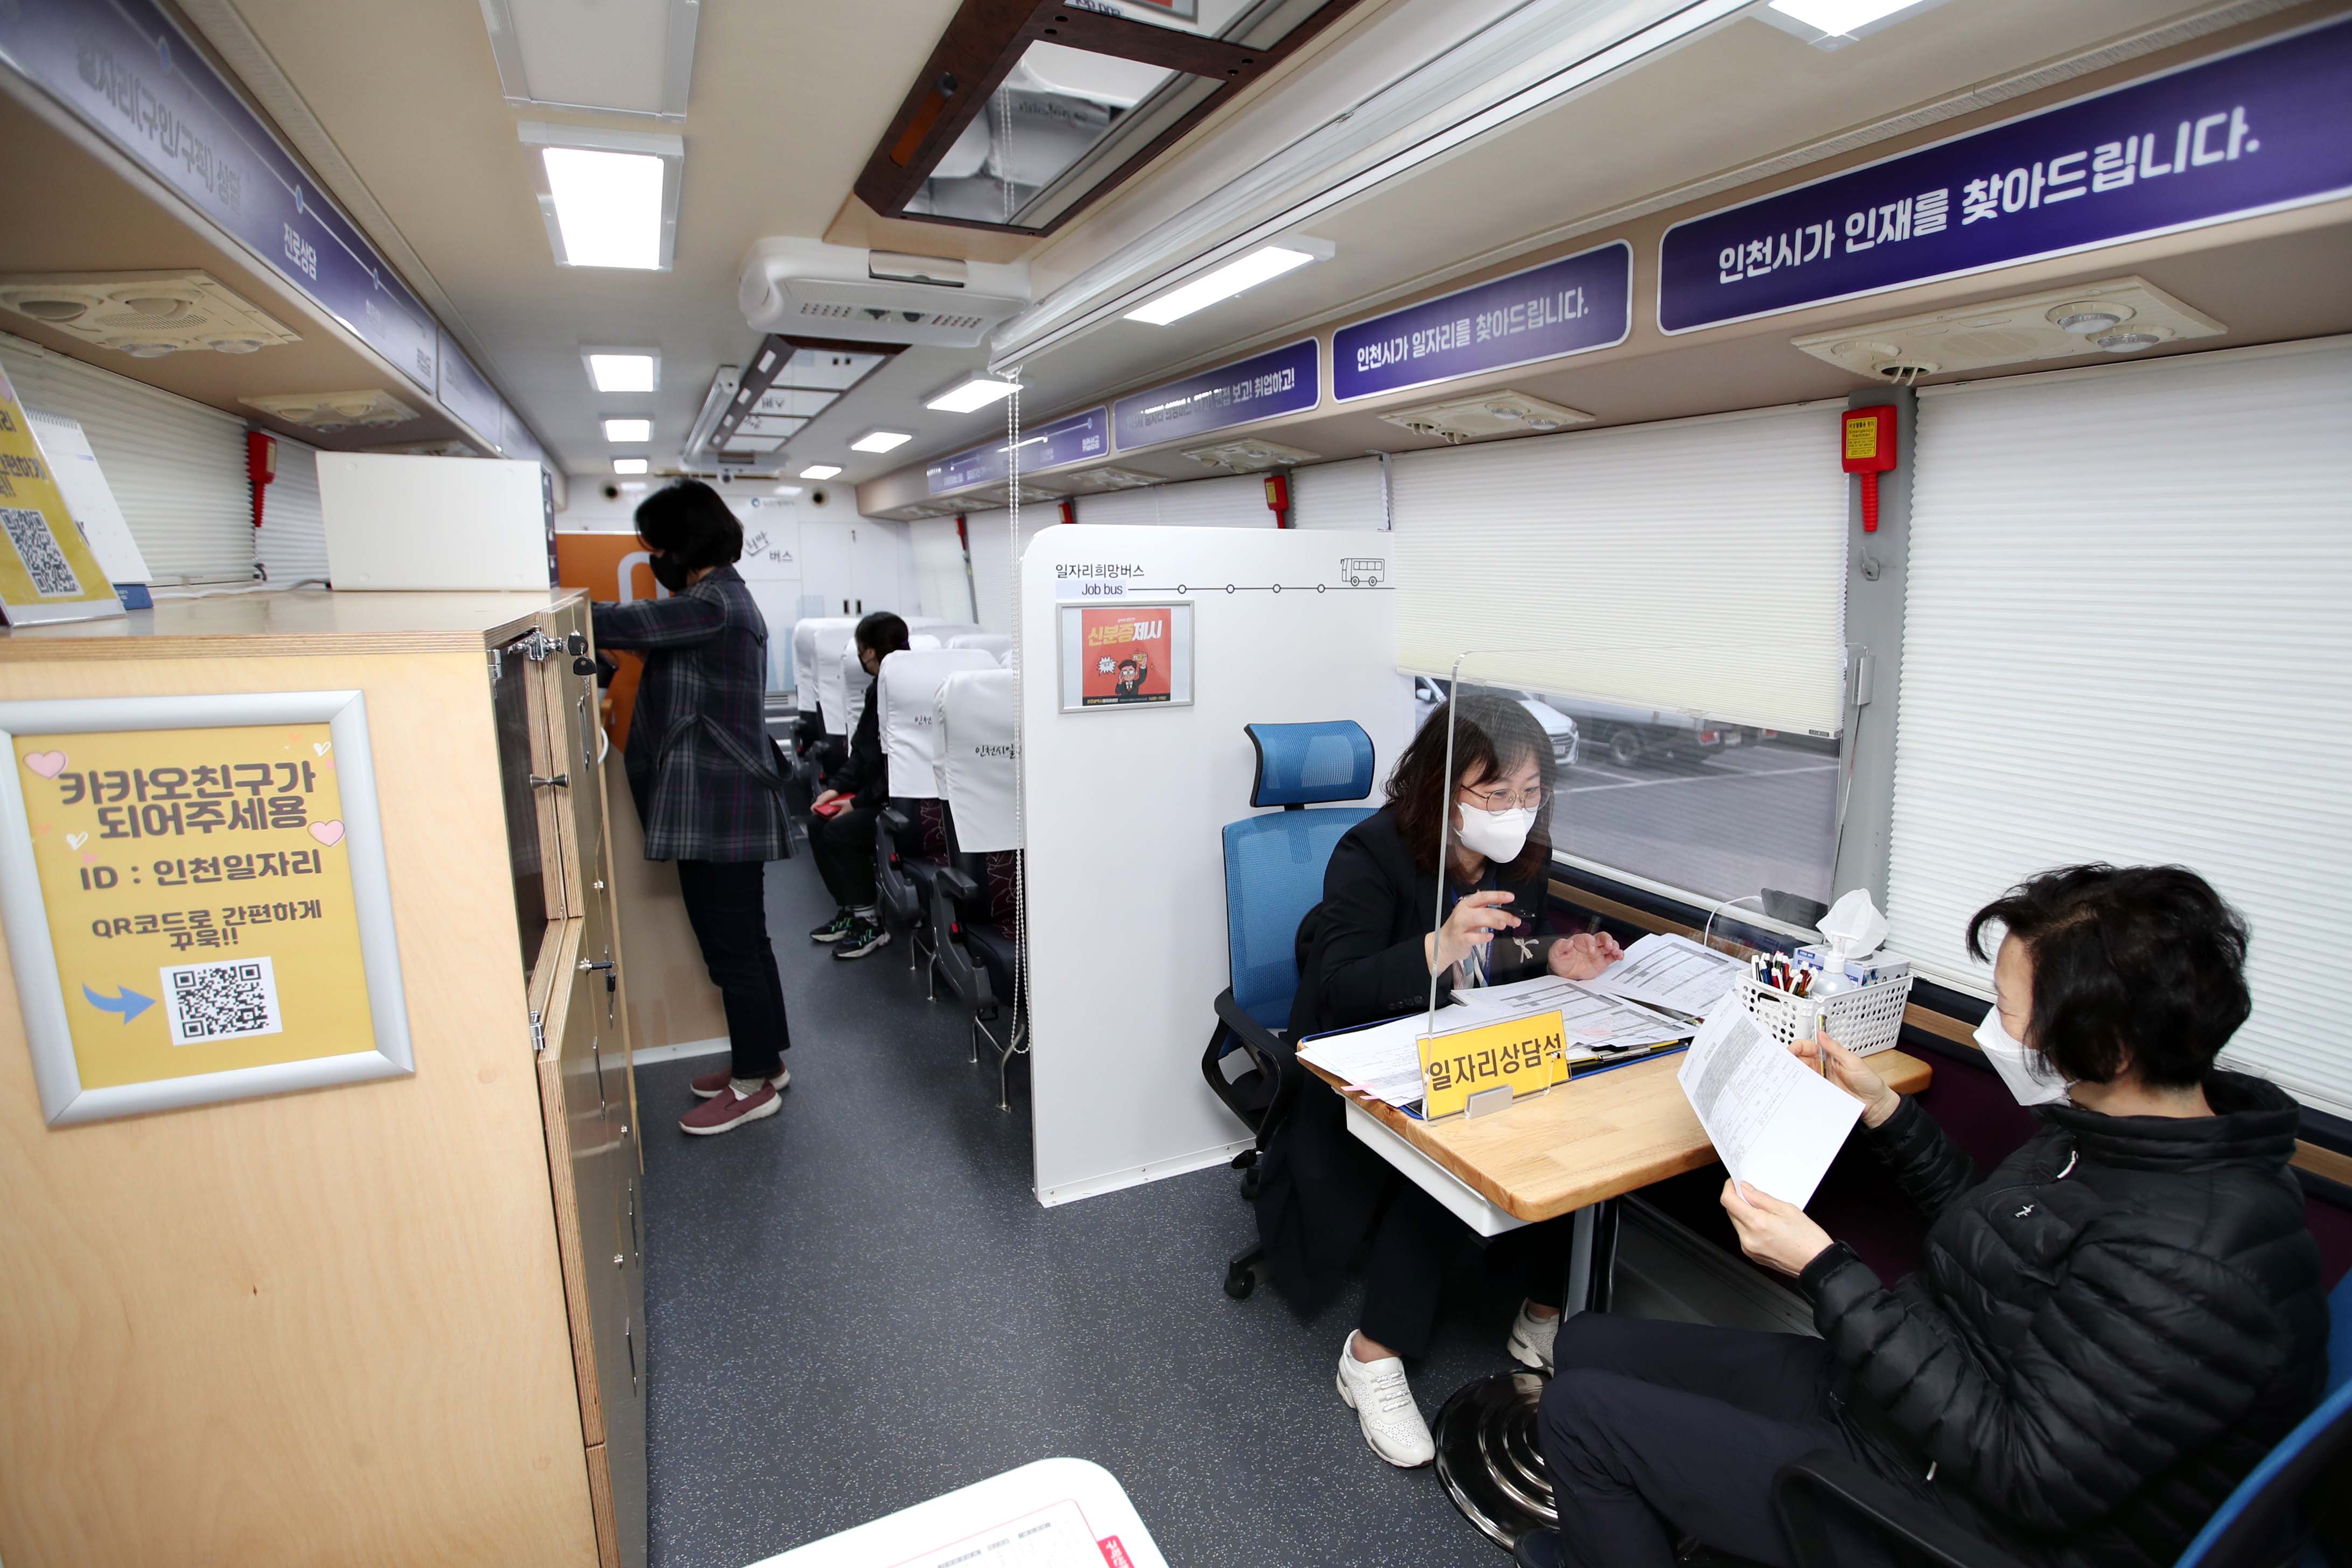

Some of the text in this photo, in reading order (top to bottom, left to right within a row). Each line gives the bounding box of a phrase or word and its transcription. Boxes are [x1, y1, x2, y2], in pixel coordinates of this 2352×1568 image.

[1718, 106, 2260, 285] 인천시가 인재를 찾아드립니다.
[284, 222, 317, 281] 진로상담
[1356, 286, 1589, 372] 인천시가 일자리를 찾아드립니다.
[1233, 380, 1252, 404] 보고!
[1254, 367, 1295, 398] 취업하고!
[769, 550, 793, 563] 버스
[1055, 564, 1145, 578] 일자리희망버스
[1082, 583, 1123, 595] Job bus
[58, 760, 317, 806] 카카오친구가
[98, 795, 309, 840] 되어주세용
[80, 866, 119, 891] ID
[153, 849, 323, 887] 인천일자리
[92, 899, 323, 939] QR코드로 간편하게
[170, 927, 239, 951] 꾸욱!!
[1430, 1033, 1562, 1091] 일자리상담석
